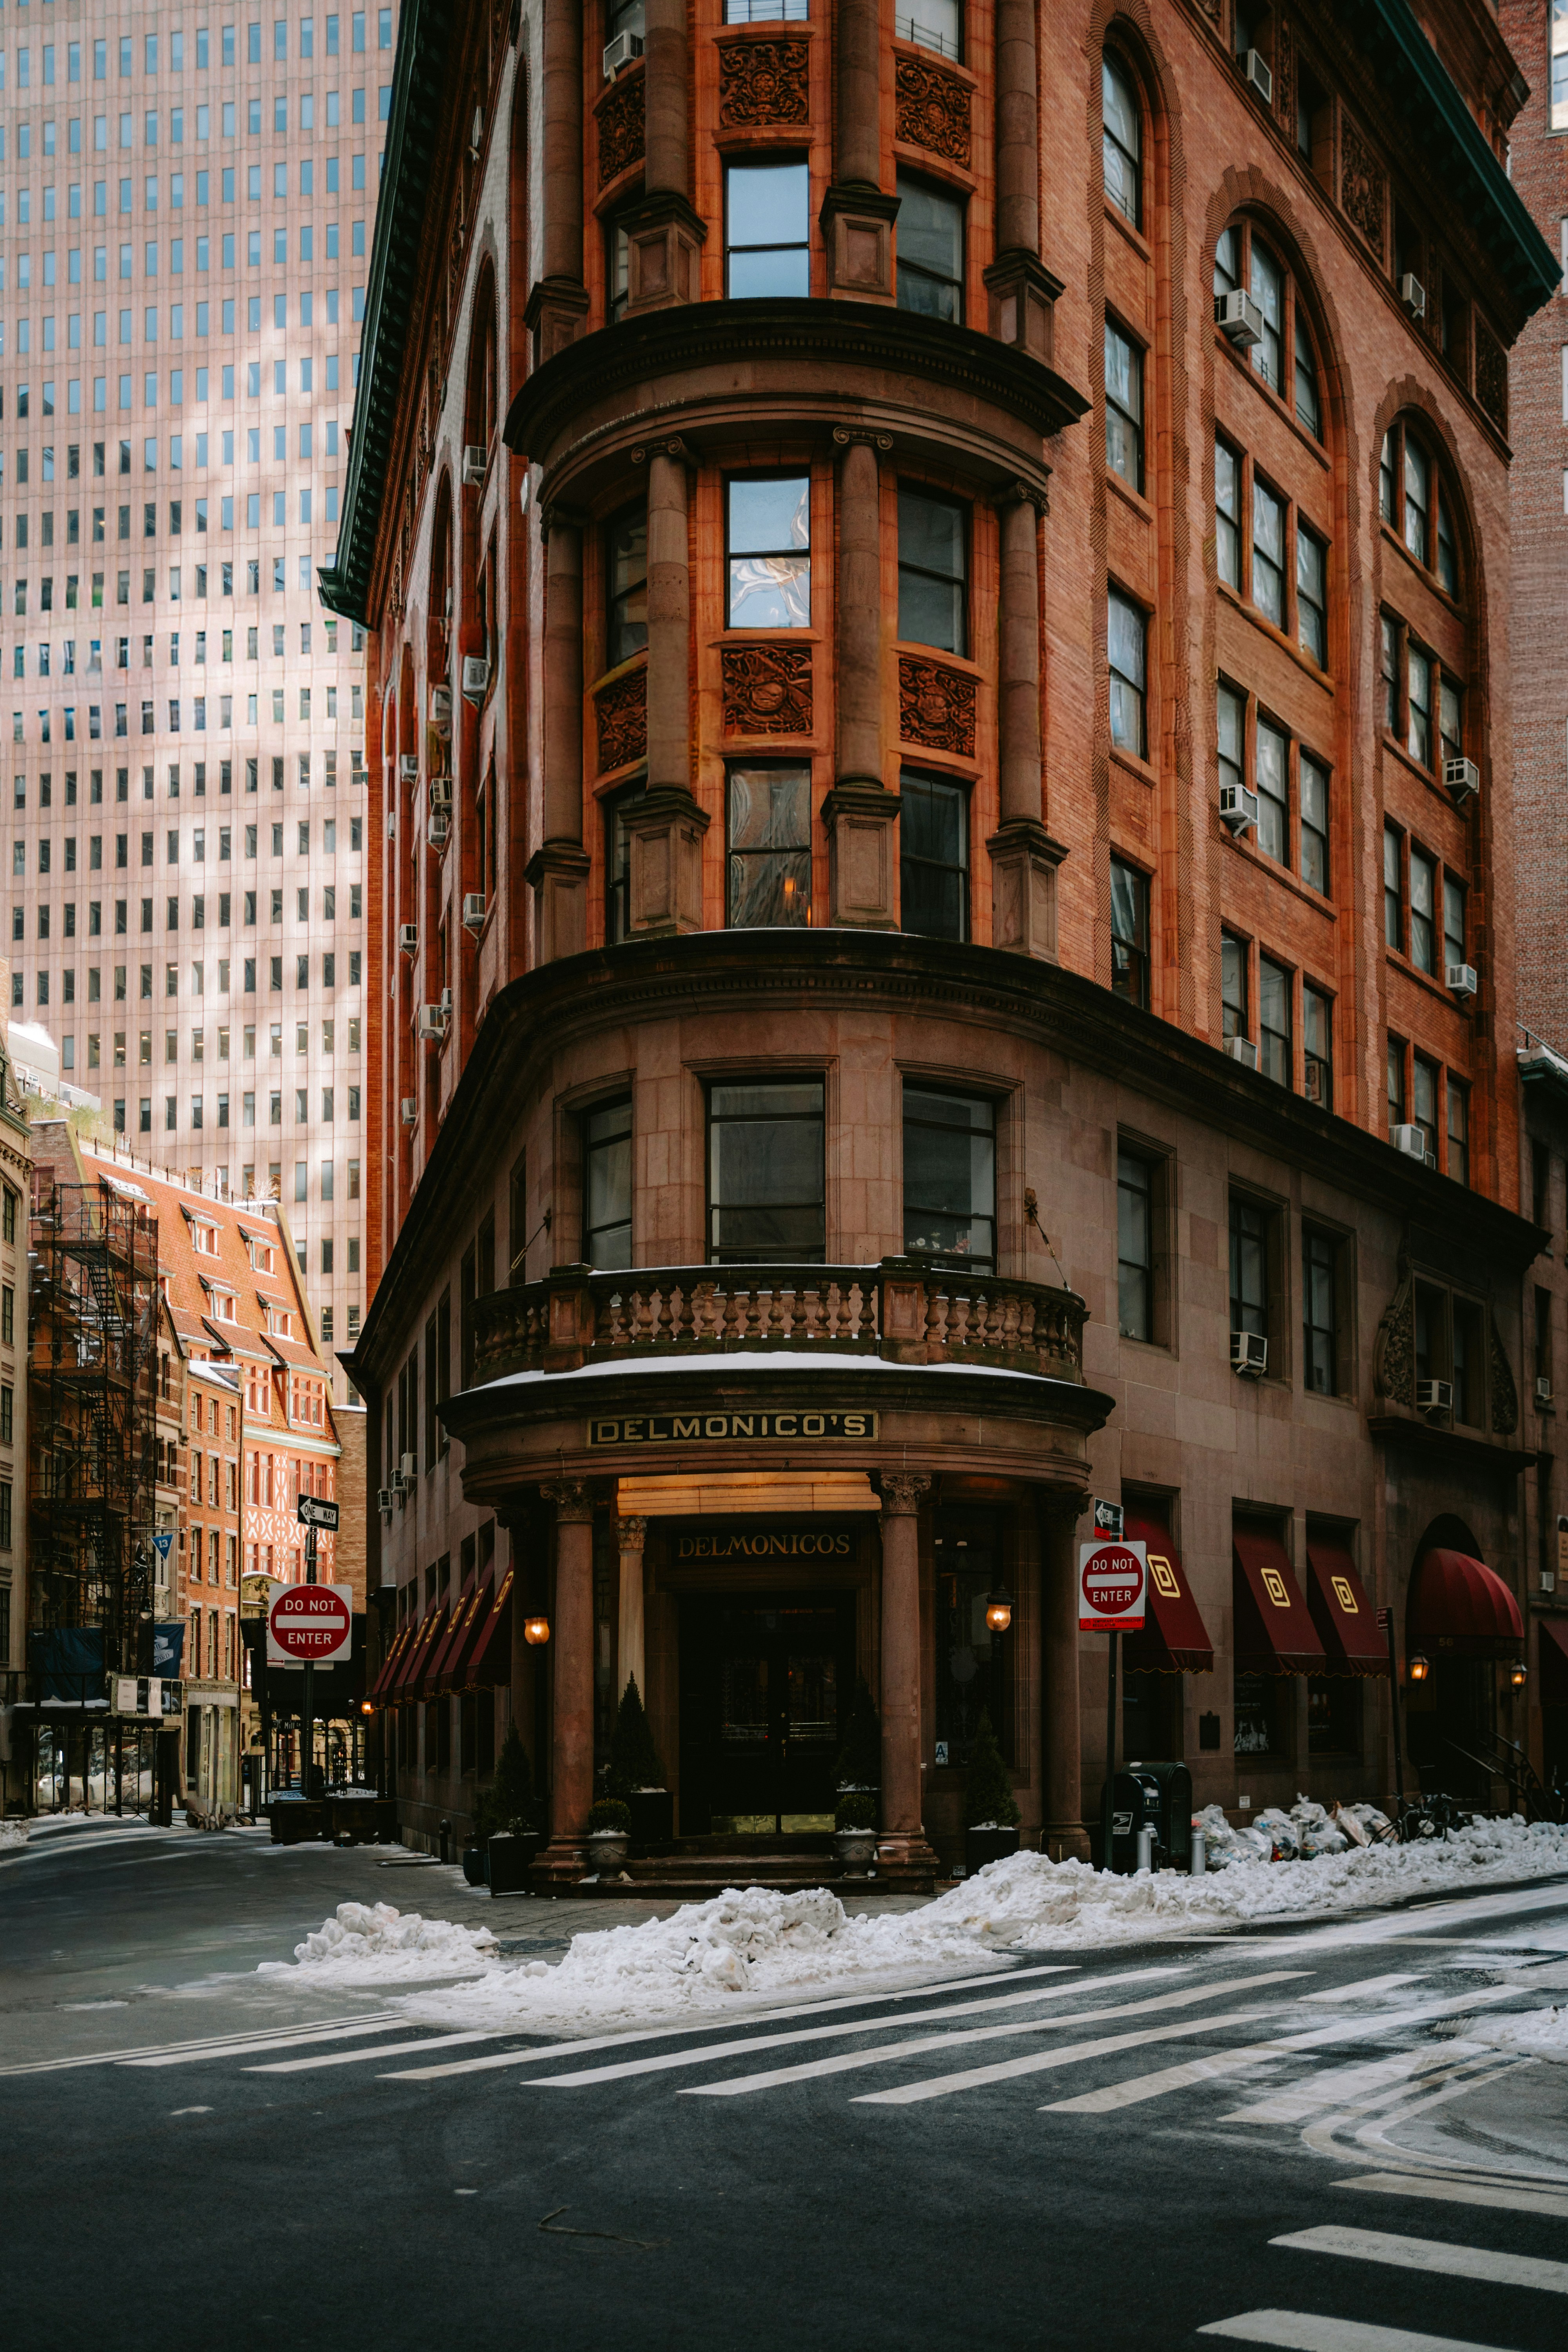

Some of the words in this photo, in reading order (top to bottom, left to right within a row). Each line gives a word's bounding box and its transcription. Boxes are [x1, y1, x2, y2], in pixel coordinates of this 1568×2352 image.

[597, 1415, 866, 1442] DELMONICO'S
[305, 1504, 316, 1518] ONE
[323, 1509, 334, 1522] WAY
[1100, 1509, 1109, 1522] ONE
[158, 1539, 169, 1548] 13
[678, 1534, 850, 1557] DELMONICOS
[1092, 1559, 1108, 1571] DO
[1112, 1558, 1134, 1570] NOT
[1093, 1590, 1132, 1602] ENTER
[285, 1599, 304, 1611] DO
[309, 1600, 336, 1612] NOT
[288, 1632, 332, 1644] ENTER
[154, 1653, 170, 1664] FORD
[285, 1721, 295, 1730] Mill
[936, 1744, 946, 1758] A
